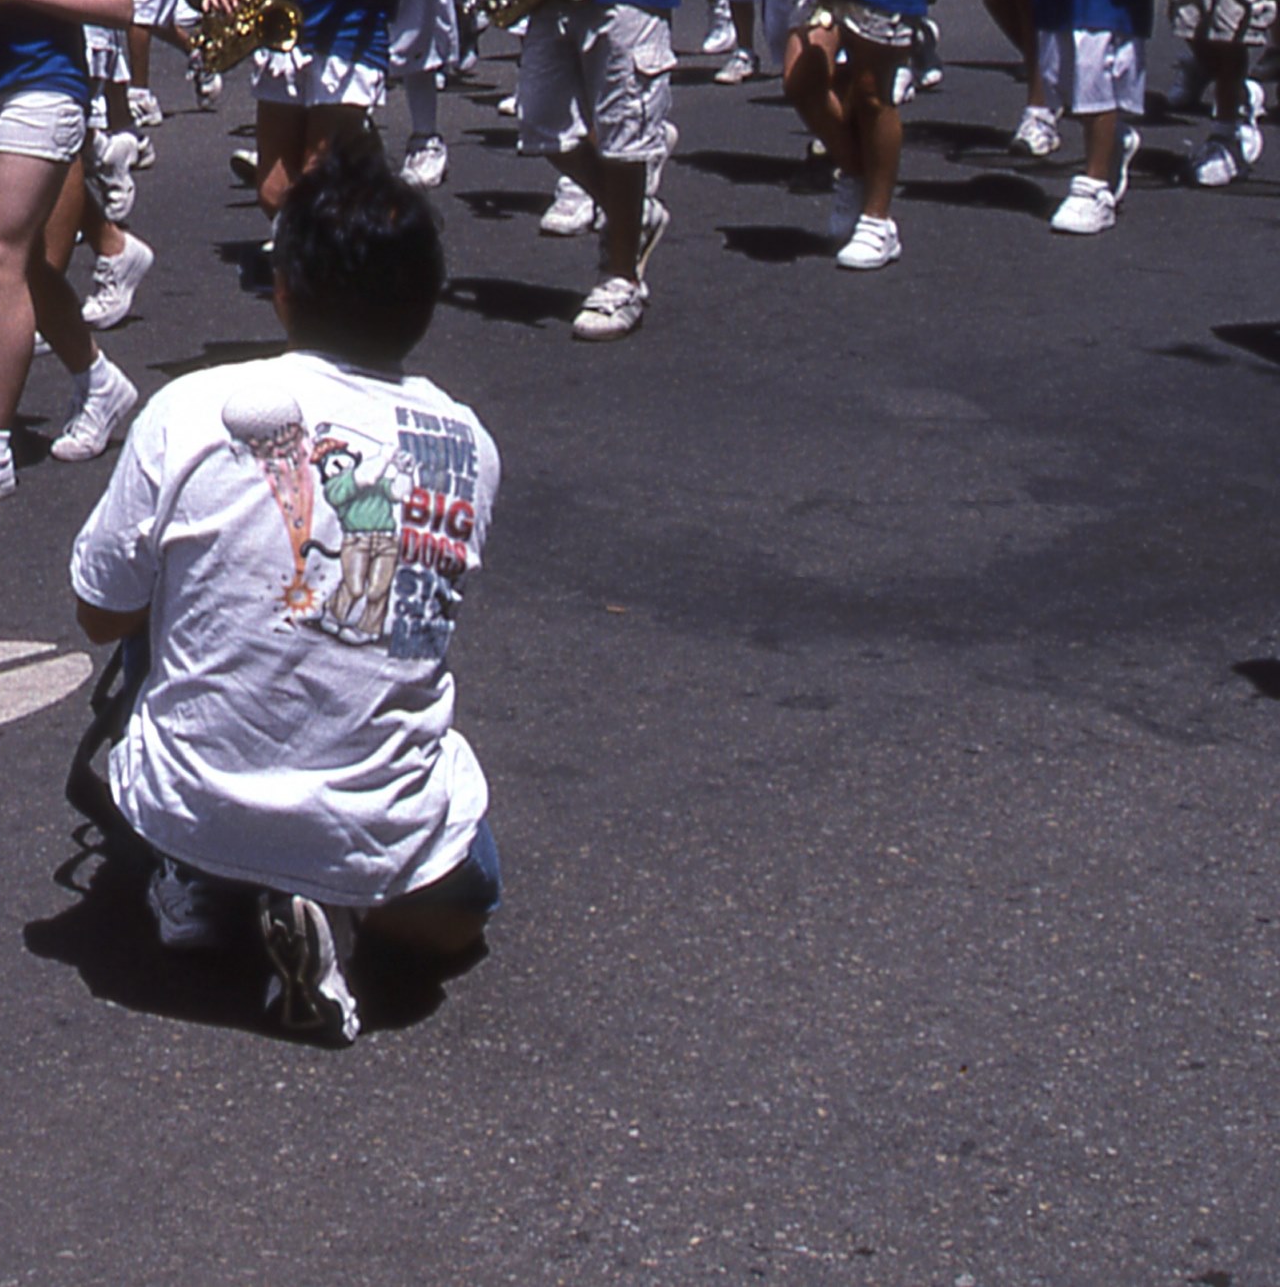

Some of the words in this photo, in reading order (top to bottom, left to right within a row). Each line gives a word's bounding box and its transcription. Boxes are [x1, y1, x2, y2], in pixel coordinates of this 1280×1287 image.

[397, 429, 478, 479] DRIVE
[401, 486, 475, 542] BIG
[401, 526, 467, 576] DOGS
